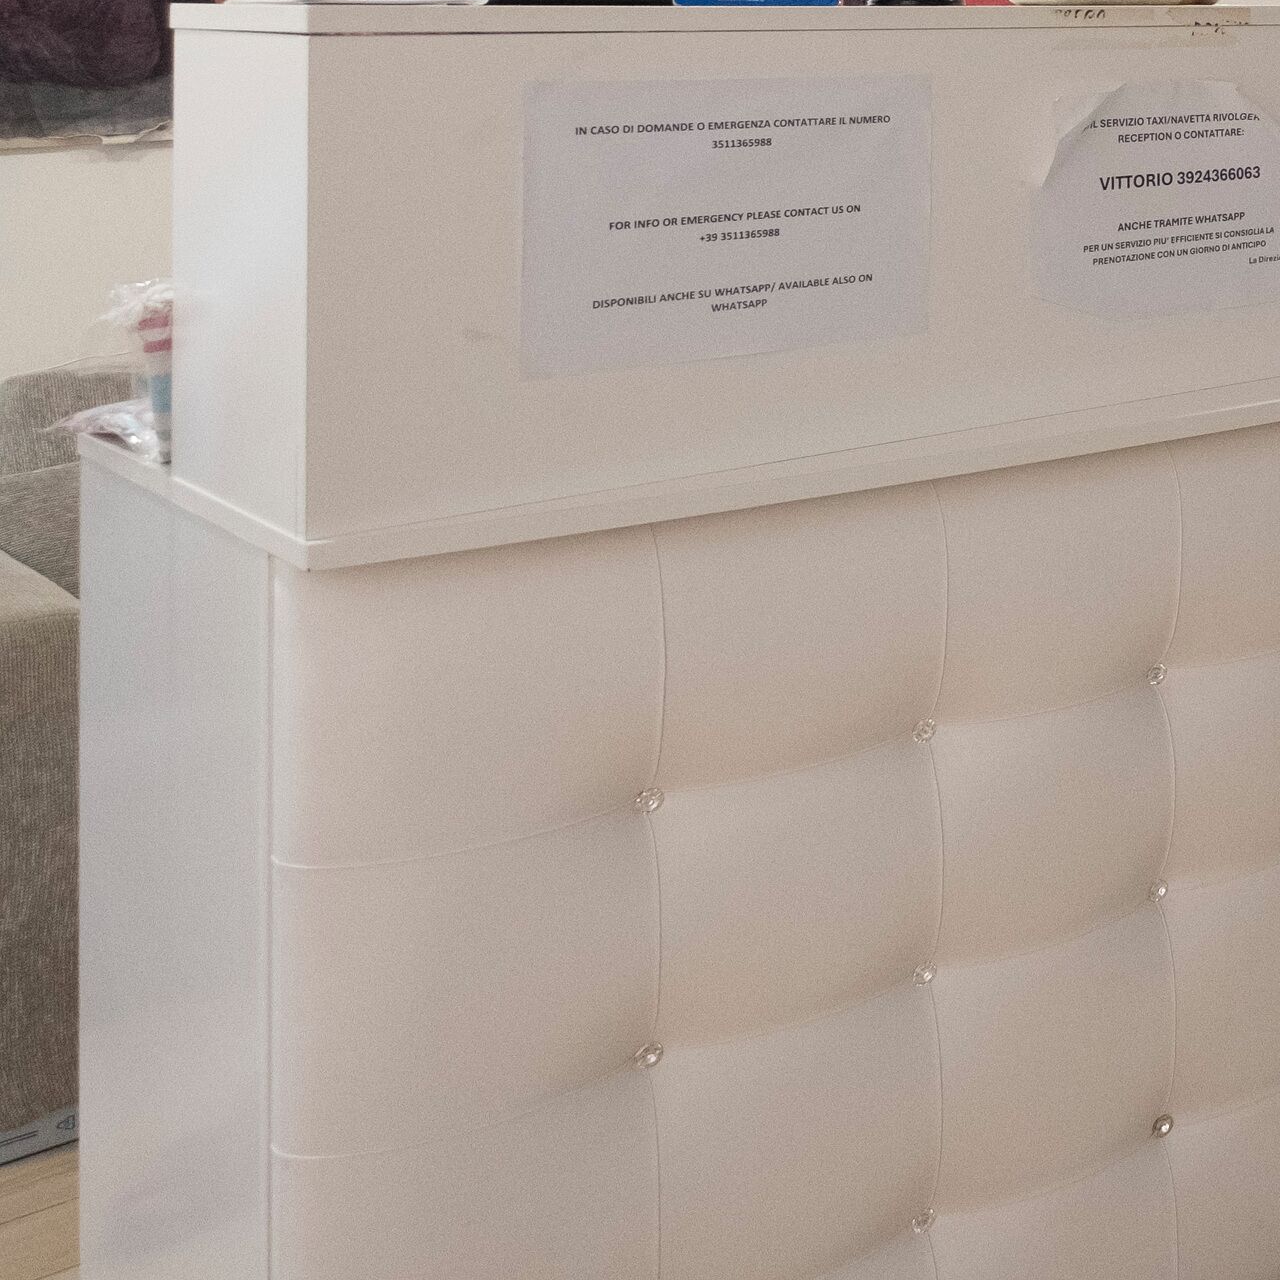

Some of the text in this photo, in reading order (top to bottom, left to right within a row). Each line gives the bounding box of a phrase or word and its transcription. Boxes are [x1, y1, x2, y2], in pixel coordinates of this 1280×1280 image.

[575, 115, 891, 136] IN CASO DI DOMANDE O EMERGENZA CONTATTARE IL NUMERO
[1100, 117, 1145, 128] SERVIZIO
[1146, 114, 1211, 125] TAXI/NAVETTA
[711, 138, 773, 149] 3511365988
[1118, 128, 1244, 143] RECEPTION O CONTATTARE:
[1099, 166, 1261, 191] VITTORIO 3924366063
[609, 204, 861, 230] FOR INFO OR EMERGENCY PLEASE CONTACT US ON
[1118, 212, 1245, 231] ANCHE TRAMITE WHATSAPP
[699, 228, 780, 242] +39 3511365988
[1083, 245, 1100, 253] PER
[1101, 243, 1114, 251] UN
[1115, 239, 1152, 250] SERVIZIO
[1171, 232, 1214, 243] EFFICIENTE
[1223, 228, 1264, 238] CONSIGLIA
[1092, 240, 1266, 266] PRENOTAZIONE CON UN GIORNO DI ANTICIPO
[592, 273, 873, 310] DISPONIBILI ANCHE SU WHATSAPP/ AVAILABLE ALSO ON
[711, 298, 768, 312] WHATSAPP
